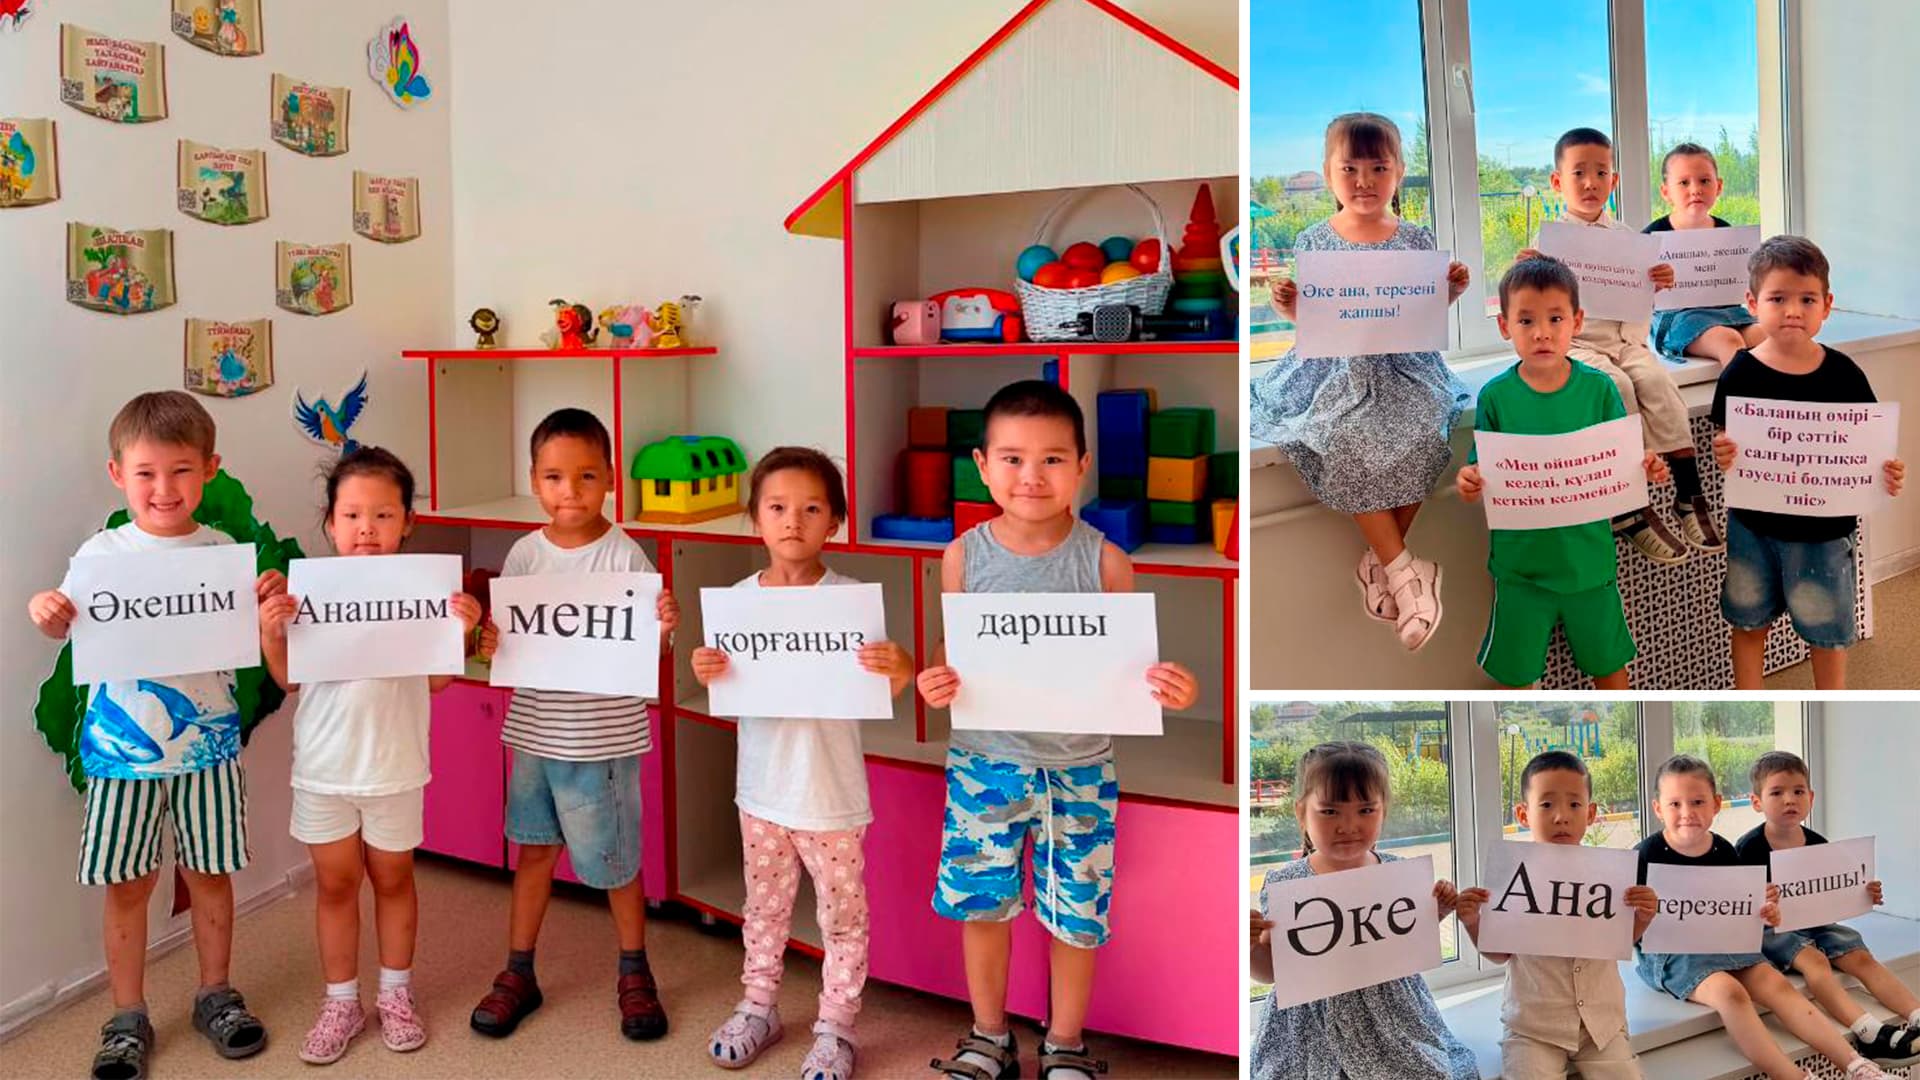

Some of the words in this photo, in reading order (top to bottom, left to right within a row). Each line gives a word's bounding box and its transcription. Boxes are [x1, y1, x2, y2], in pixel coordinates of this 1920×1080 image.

[1302, 283, 1335, 298] Әке
[1339, 286, 1370, 298] ана,
[1374, 281, 1436, 299] терезені
[1339, 304, 1401, 320] жапшы!
[1734, 402, 1822, 422] «Баланың
[1826, 408, 1869, 426] өмірі
[1767, 426, 1793, 444] бір
[1797, 430, 1849, 444] сәттік
[1495, 457, 1539, 472] «Мен
[1544, 448, 1617, 470] ойнағым
[1744, 447, 1868, 467] салғырттыққа
[1737, 468, 1797, 485] тәуелді
[1801, 473, 1873, 489] болмауы
[1492, 494, 1545, 507] кеткім
[1550, 480, 1630, 505] келмейді»
[1784, 493, 1827, 507] тиіс»
[88, 582, 236, 623] Әкешім
[293, 594, 449, 625] Анашым
[507, 589, 636, 641] мені
[977, 613, 1108, 645] даршы
[715, 631, 865, 661] қорғаңыз
[1491, 861, 1617, 920] Ана
[1775, 863, 1868, 899] жапшы!
[1656, 892, 1753, 920] терезені
[1287, 896, 1417, 957] Әке
